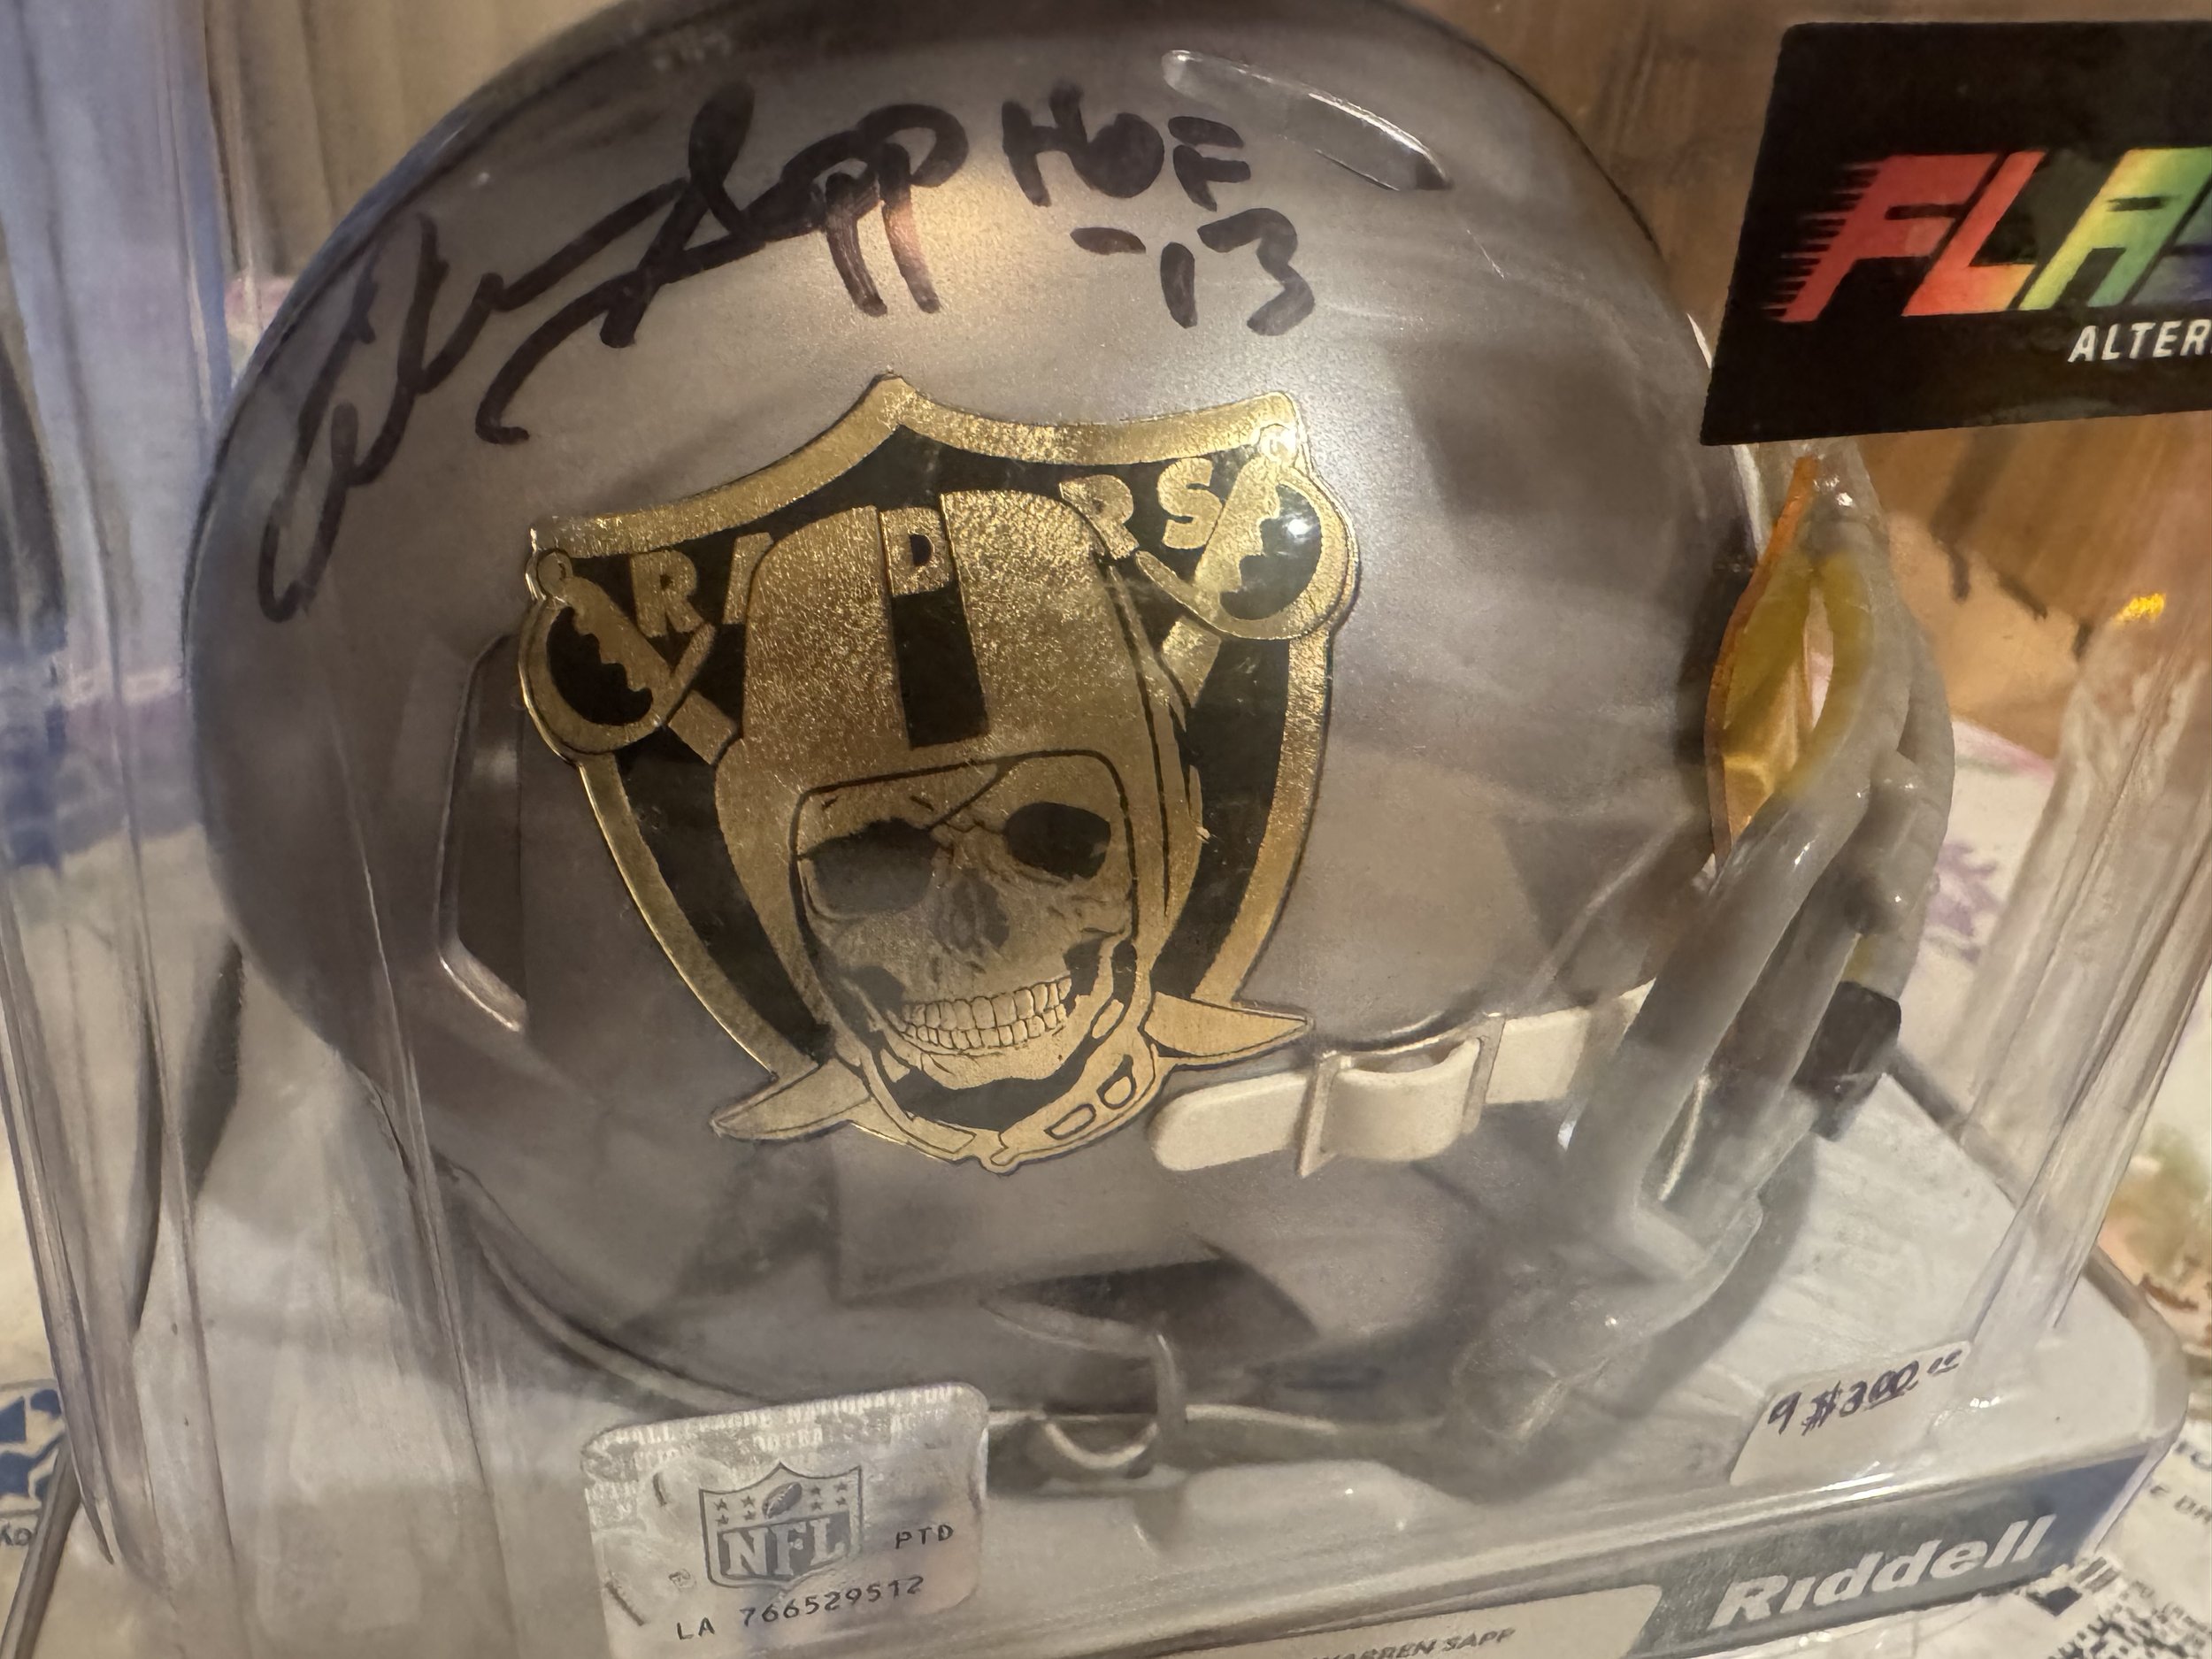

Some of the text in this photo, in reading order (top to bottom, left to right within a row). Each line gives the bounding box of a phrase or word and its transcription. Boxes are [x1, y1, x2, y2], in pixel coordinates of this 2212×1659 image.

[1002, 81, 1251, 212] HOF
[721, 1517, 848, 1577] NFL
[895, 1524, 955, 1549] PTD
[1708, 1514, 2057, 1631] Riddell
[676, 1617, 716, 1640] LA
[740, 1575, 925, 1626] 766529512
[1312, 1626, 1517, 1659] RREN SAPP
